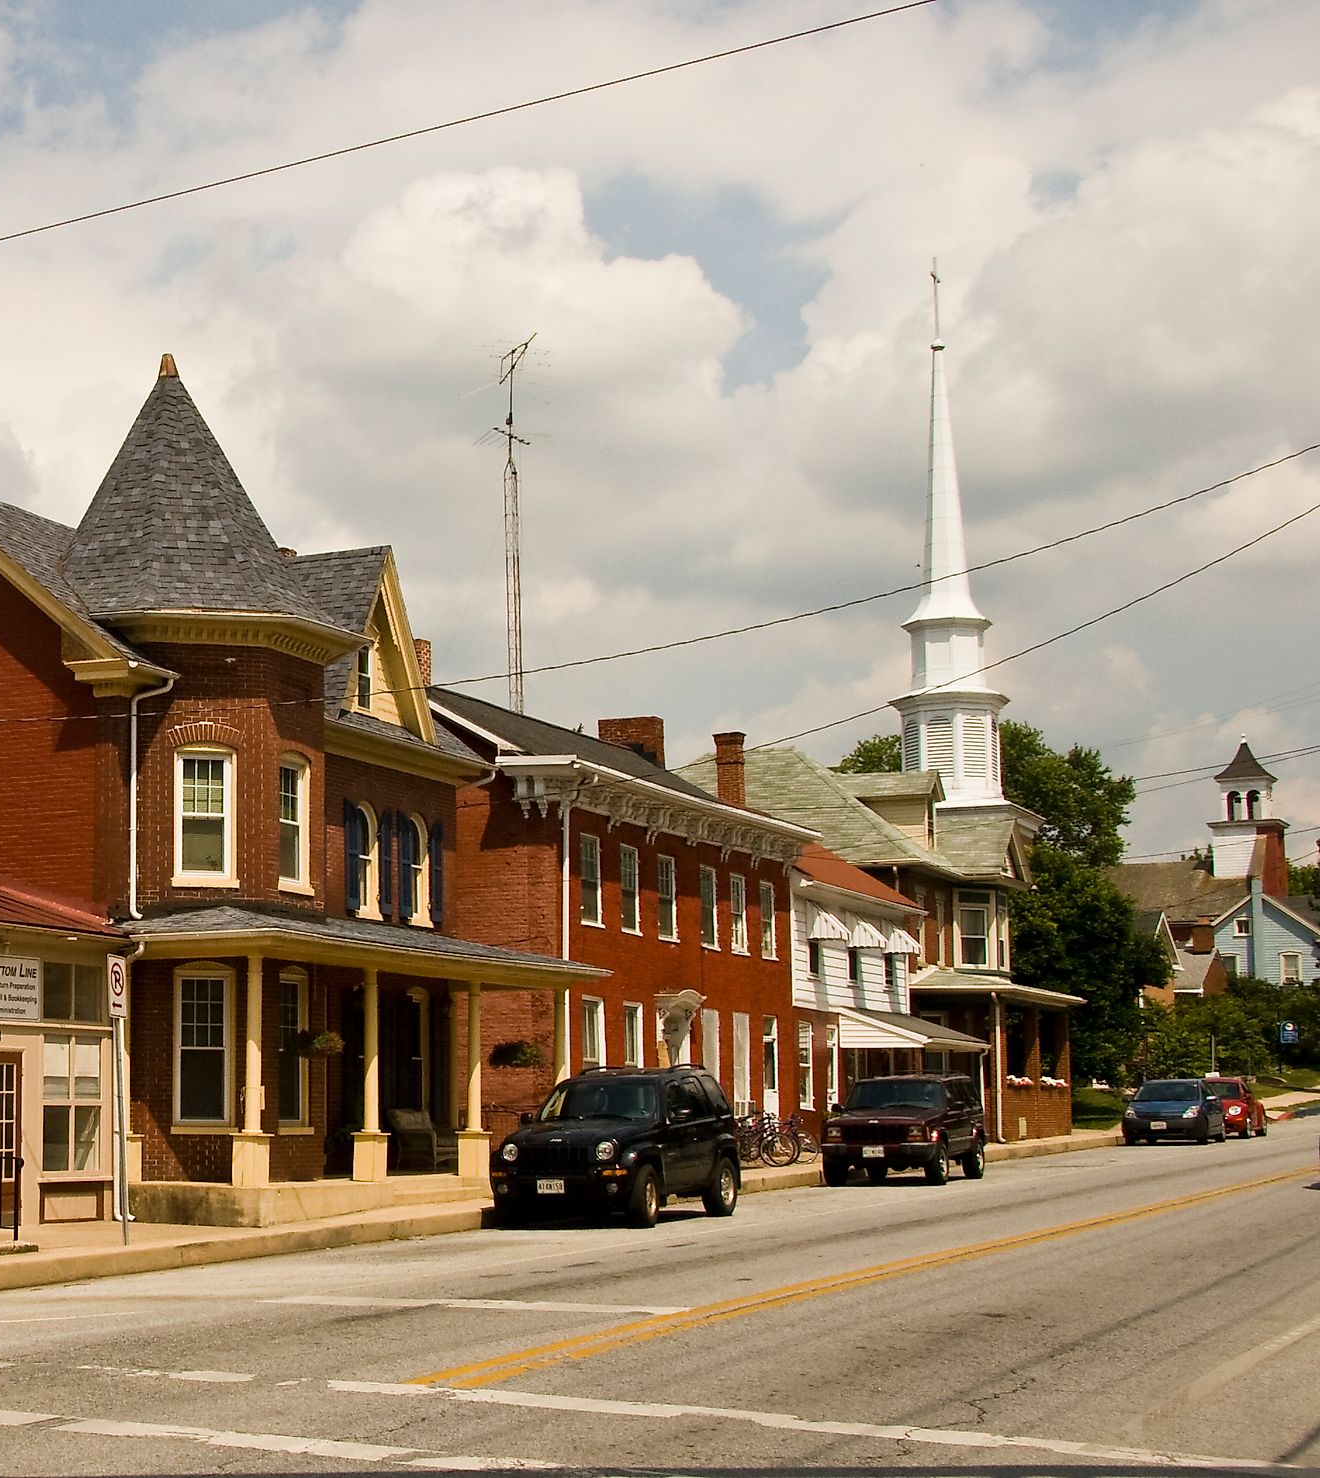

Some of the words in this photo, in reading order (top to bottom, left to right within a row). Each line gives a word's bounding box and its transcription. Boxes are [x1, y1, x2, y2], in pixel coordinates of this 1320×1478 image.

[19, 963, 37, 978] LINE
[9, 982, 36, 991] Preparation
[8, 994, 37, 1004] Bookkeeping
